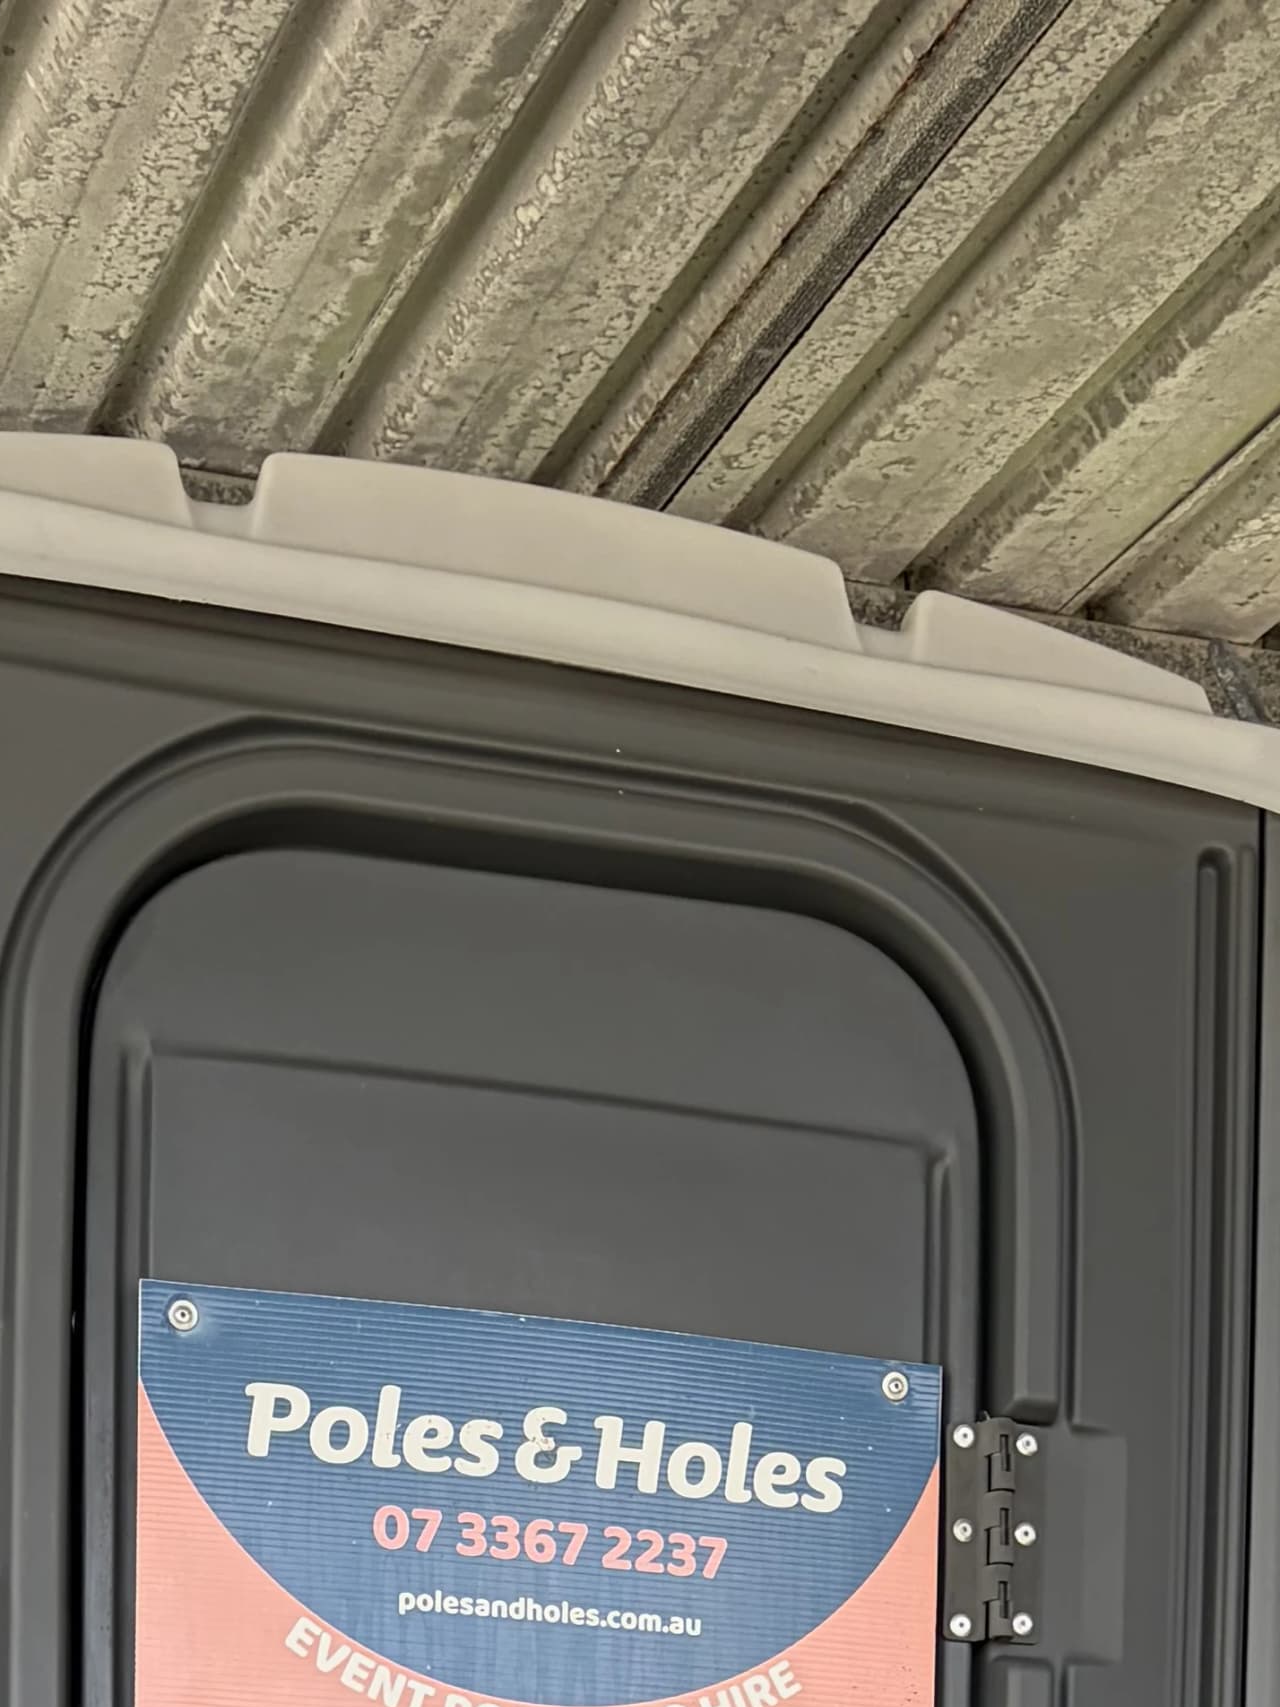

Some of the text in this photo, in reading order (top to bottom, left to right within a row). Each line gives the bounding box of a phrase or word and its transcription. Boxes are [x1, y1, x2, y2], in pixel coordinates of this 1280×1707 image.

[245, 1382, 847, 1513] Poles & Holes
[373, 1504, 728, 1579] 07 3367 2237
[398, 1590, 702, 1636] polesandholes.com.au
